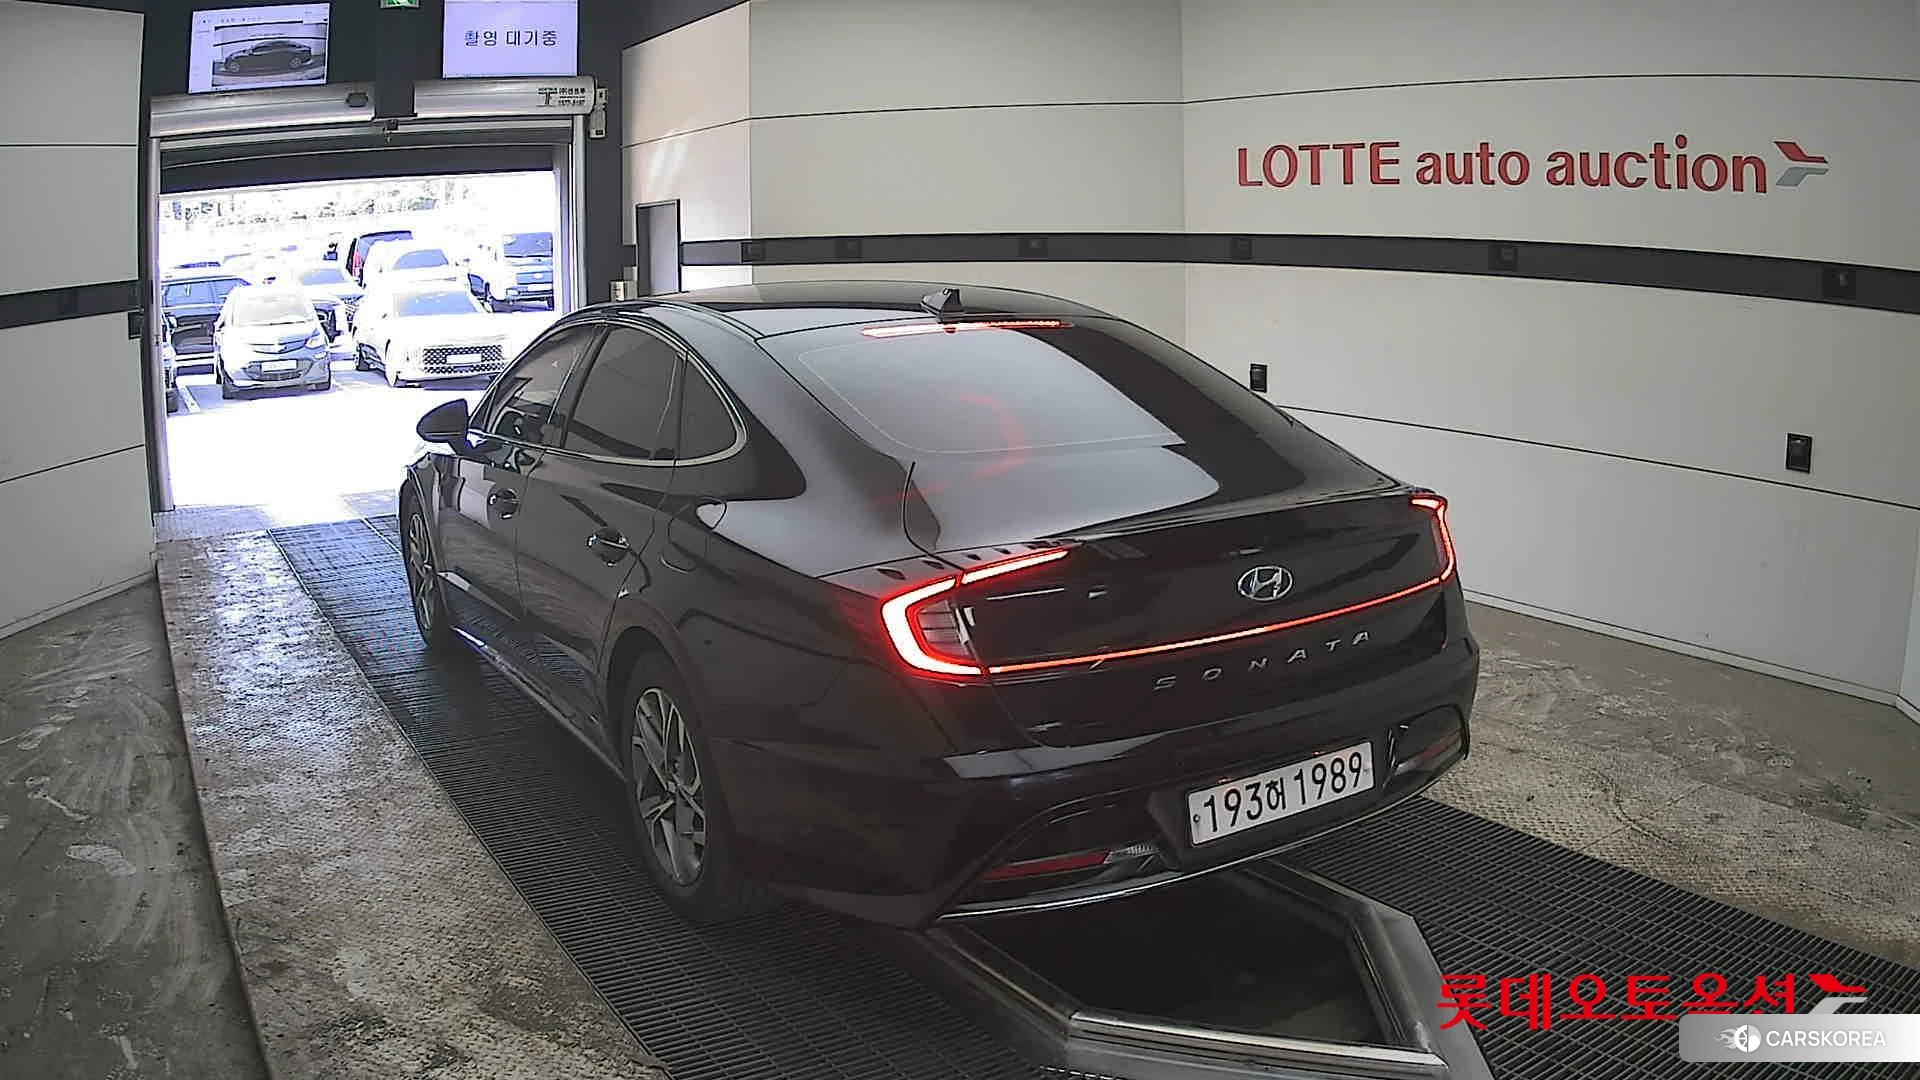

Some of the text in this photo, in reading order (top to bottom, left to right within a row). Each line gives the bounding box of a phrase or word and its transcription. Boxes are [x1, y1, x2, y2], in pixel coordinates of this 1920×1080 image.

[505, 29, 558, 46] 대기중
[1237, 134, 1768, 194] LOTTE auto auction
[1153, 630, 1370, 691] SONATA
[1293, 750, 1363, 806] 1989
